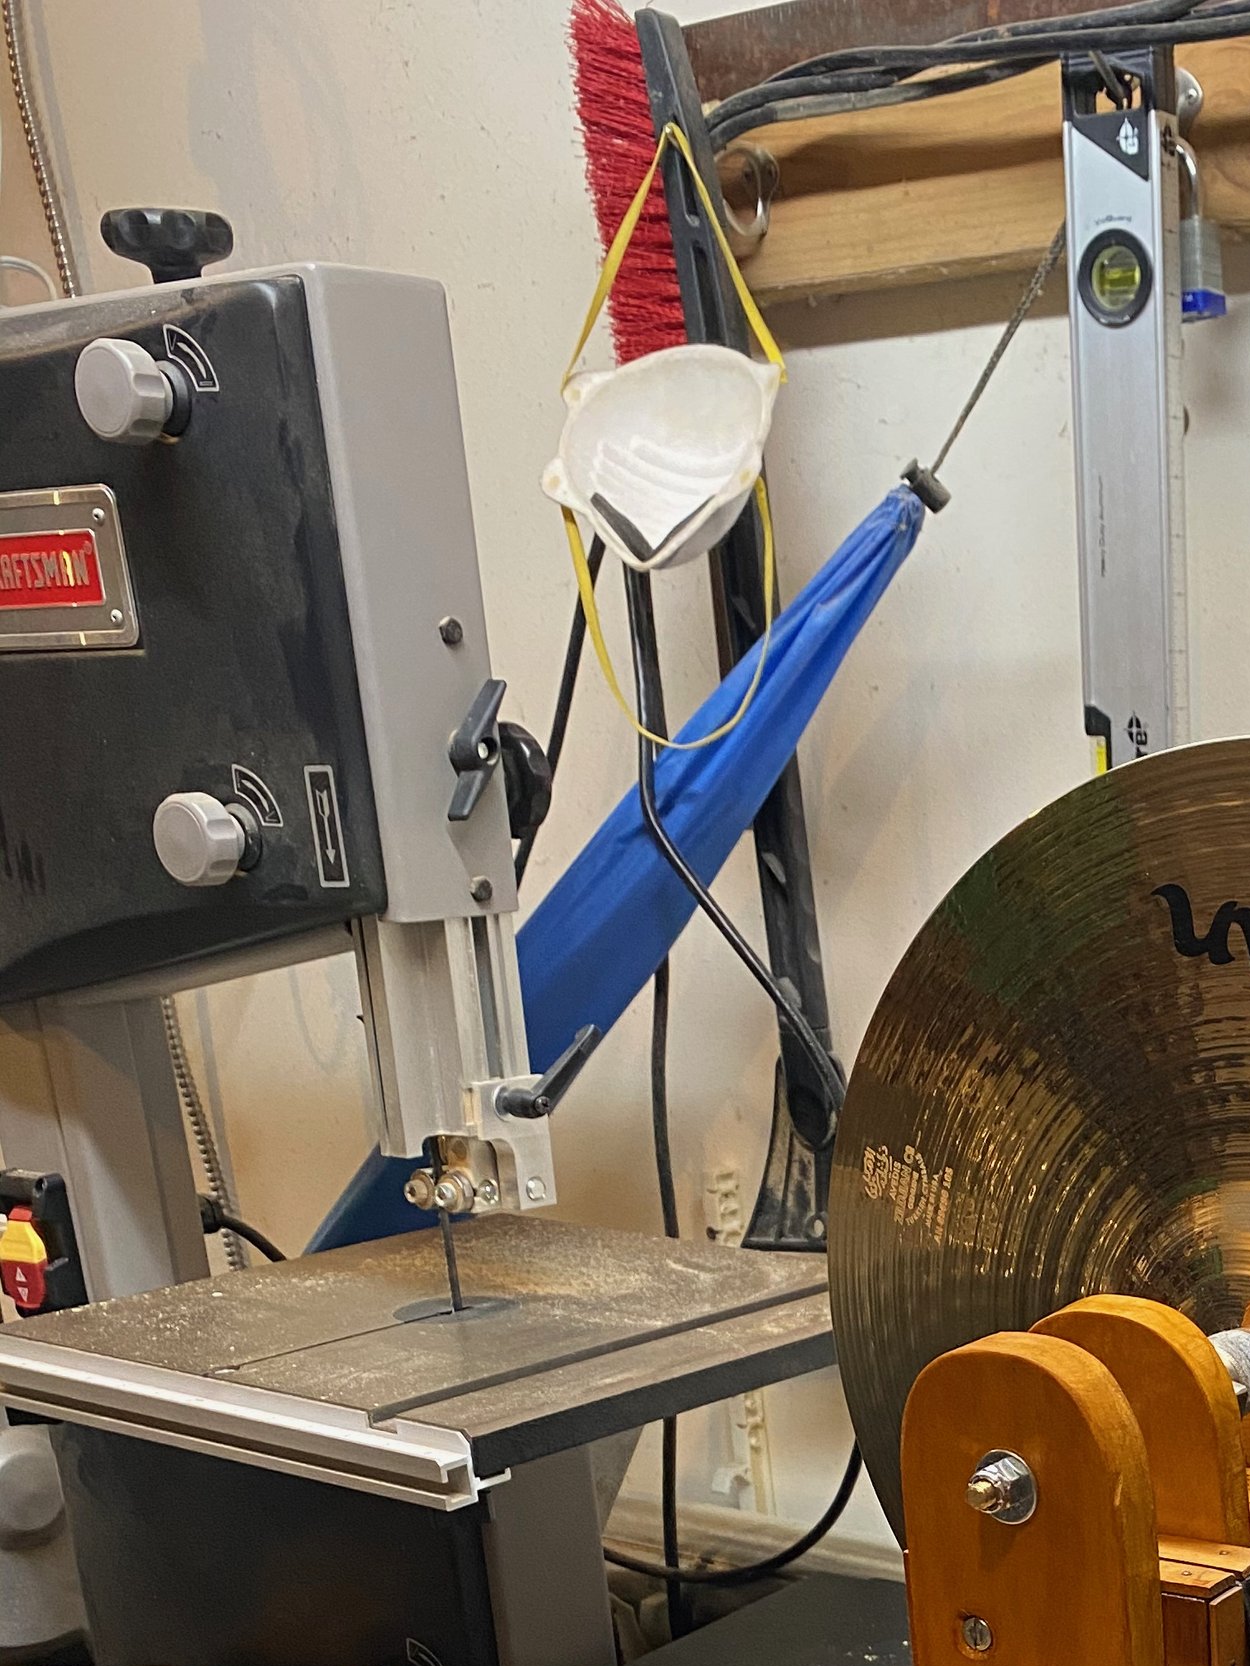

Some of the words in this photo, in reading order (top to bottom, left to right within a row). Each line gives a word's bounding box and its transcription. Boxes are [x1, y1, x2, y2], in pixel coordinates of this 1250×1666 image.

[0, 551, 89, 590] AFTSMAN
[889, 1161, 901, 1200] AVEDIS
[894, 1165, 912, 1225] ZILDJIAN
